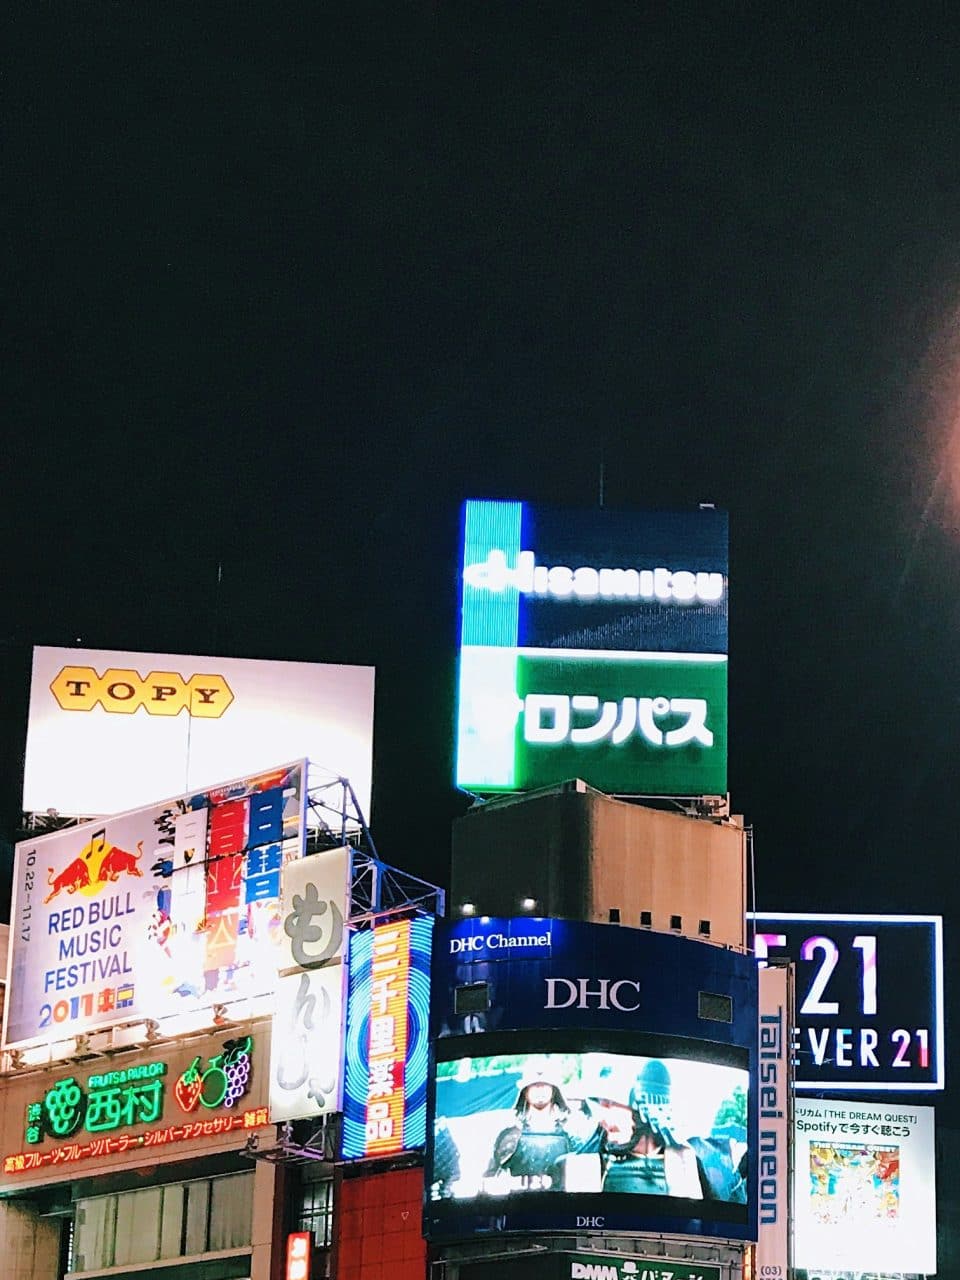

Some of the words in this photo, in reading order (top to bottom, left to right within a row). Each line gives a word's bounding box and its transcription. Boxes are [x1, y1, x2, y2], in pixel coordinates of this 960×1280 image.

[66, 680, 220, 704] TOPY
[518, 694, 715, 747] ロンパス
[48, 907, 84, 935] RED
[89, 892, 135, 920] BULL
[59, 925, 122, 961] MUSIC
[450, 936, 484, 953] DHC
[486, 932, 552, 949] Channel
[44, 952, 132, 993] FESTIVAL
[544, 978, 641, 1012] DHC
[760, 1006, 784, 1119] Taisei
[891, 1028, 930, 1068] 21
[26, 1104, 41, 1144] 渋谷
[86, 1080, 164, 1132] 西村
[849, 1112, 882, 1122] DREAM
[796, 1120, 911, 1138] Spotifyで今すぐ聴こう
[760, 1131, 778, 1224] neon
[576, 1216, 604, 1228] DHC
[760, 1265, 783, 1277] (03)
